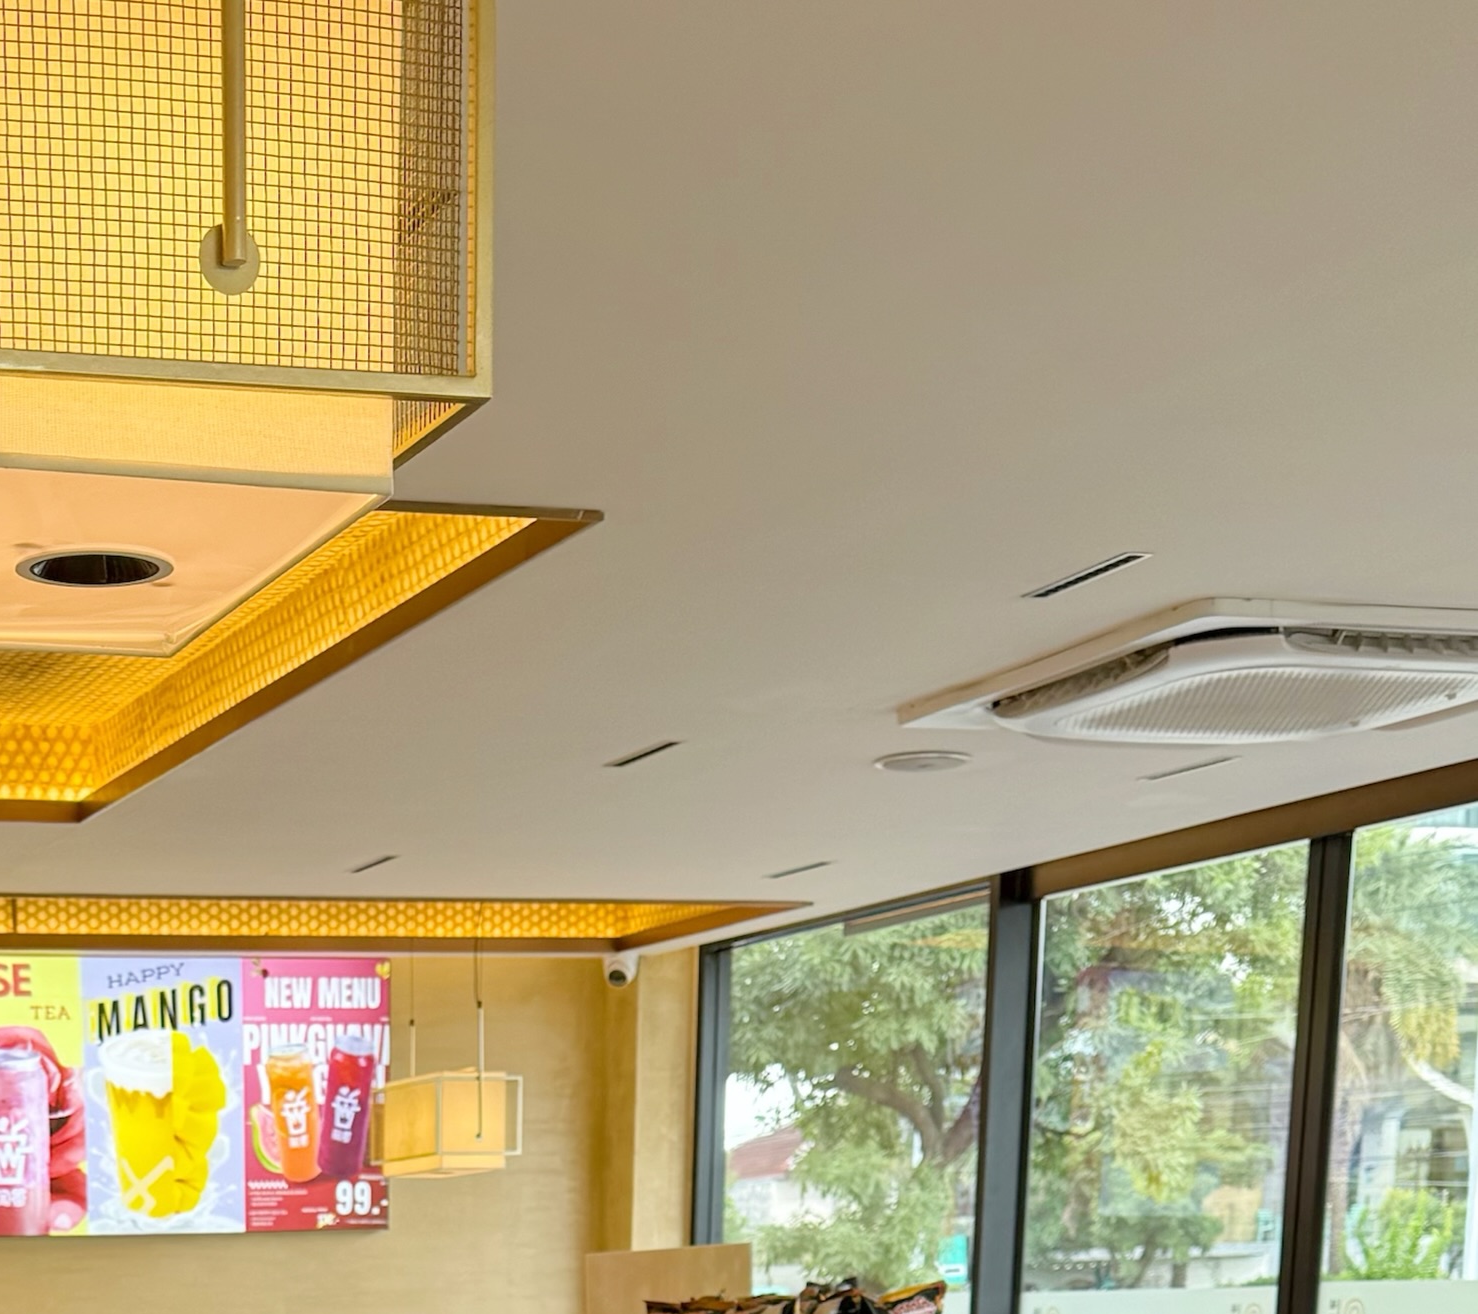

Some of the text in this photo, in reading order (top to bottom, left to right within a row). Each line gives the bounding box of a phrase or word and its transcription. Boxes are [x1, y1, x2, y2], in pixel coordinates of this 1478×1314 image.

[107, 962, 185, 989] HAPPY
[264, 976, 382, 1010] NEW MENU
[30, 1005, 71, 1021] TEA
[97, 979, 234, 1044] MANGO
